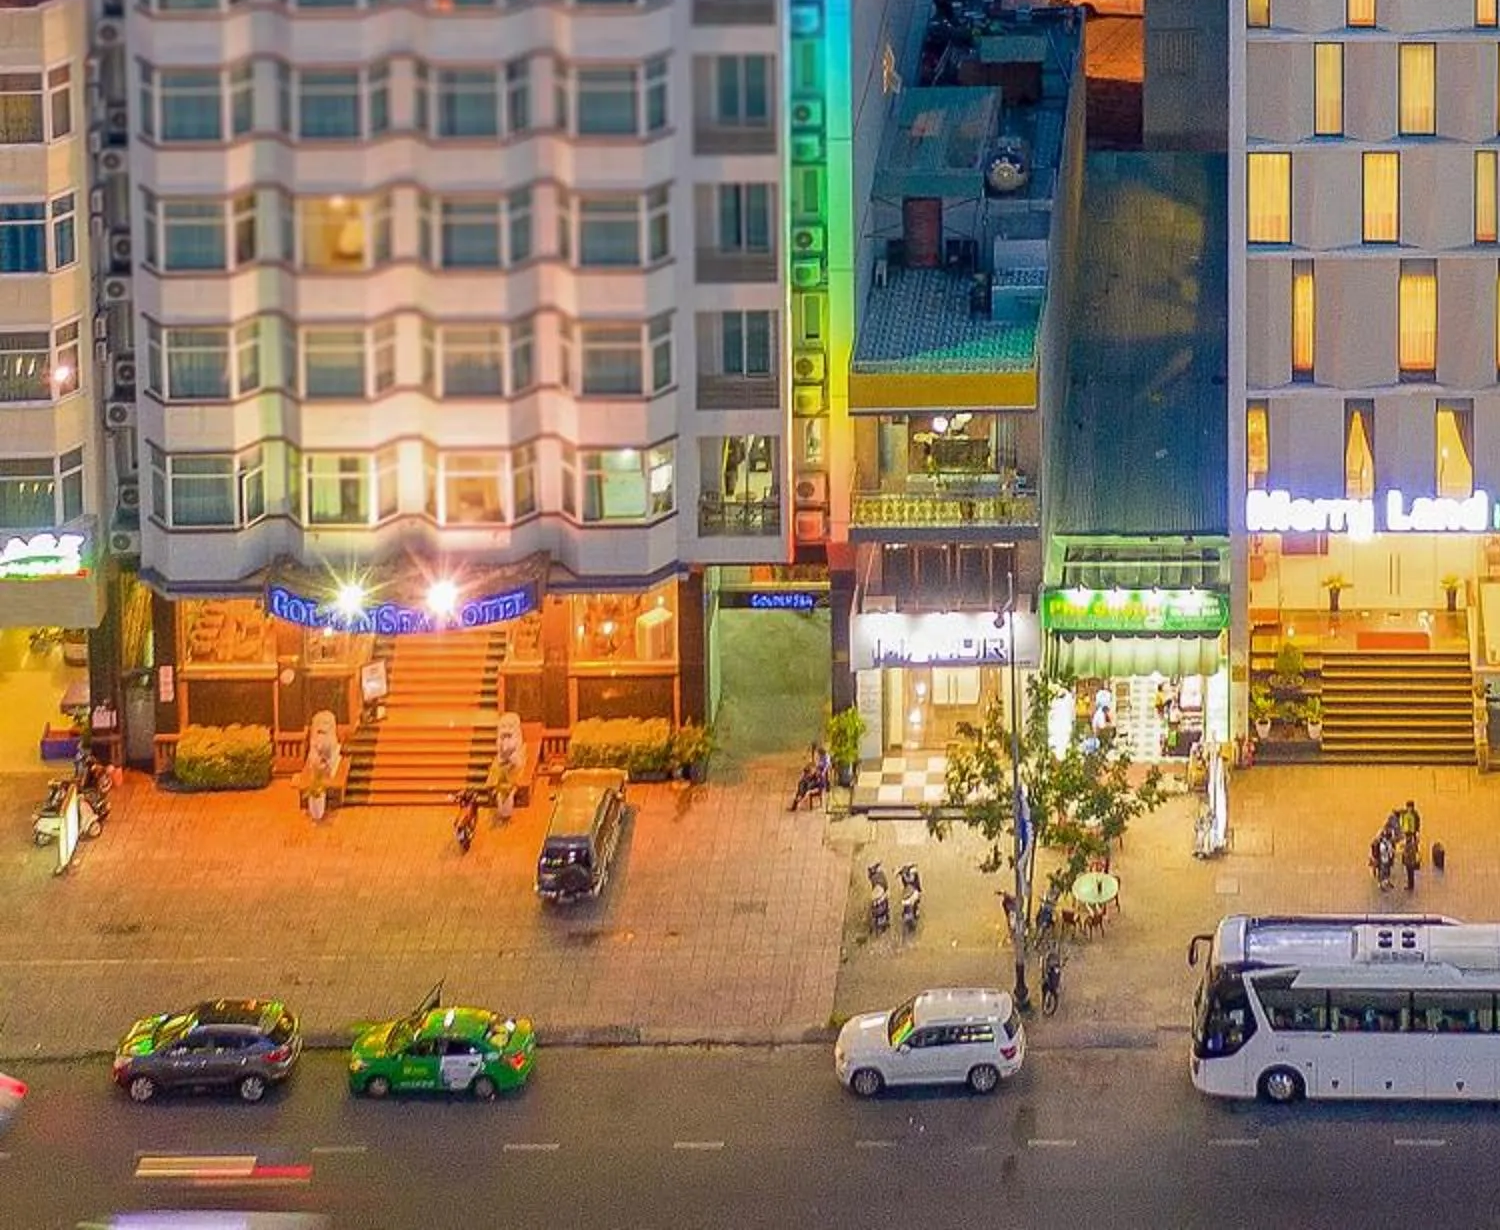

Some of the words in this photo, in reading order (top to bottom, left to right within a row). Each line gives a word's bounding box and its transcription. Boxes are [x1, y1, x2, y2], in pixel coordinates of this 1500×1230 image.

[1247, 489, 1374, 542] Merry
[1388, 489, 1488, 531] Land
[440, 591, 527, 630] OTEL
